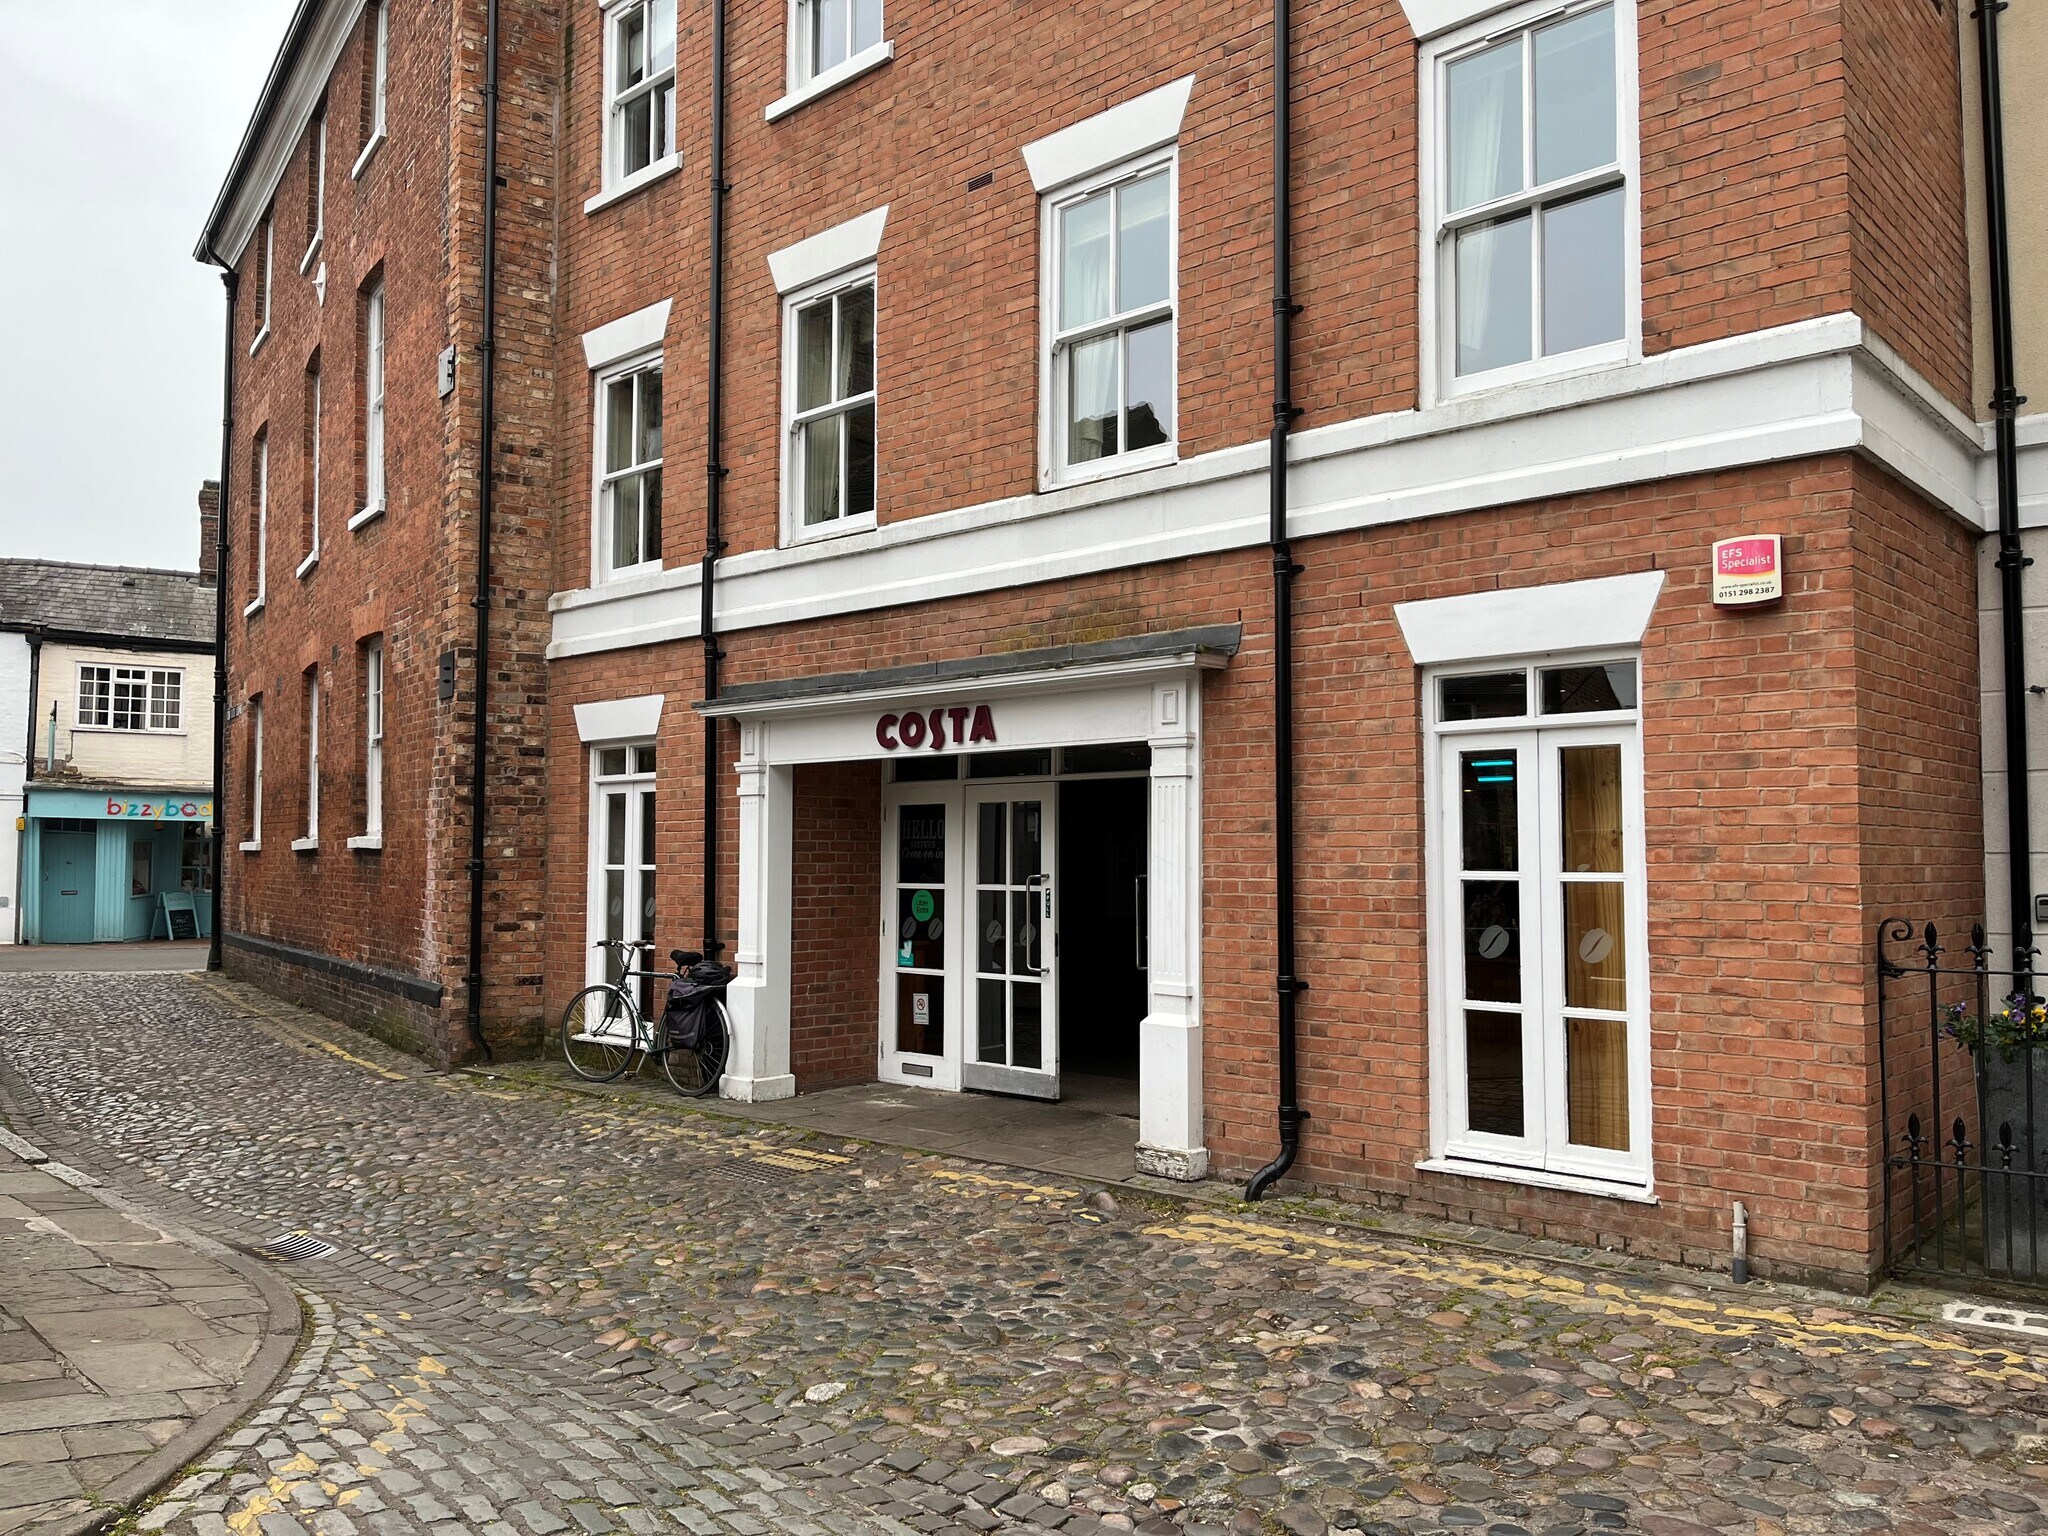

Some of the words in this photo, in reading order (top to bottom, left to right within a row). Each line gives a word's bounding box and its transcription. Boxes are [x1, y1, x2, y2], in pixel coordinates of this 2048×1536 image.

[1721, 548, 1742, 558] EFS
[1722, 555, 1771, 570] Specialist
[1719, 590, 1737, 598] 0151
[1738, 588, 1753, 596] 298
[1754, 586, 1775, 595] 2387
[876, 705, 996, 750] COSTA
[902, 819, 945, 839] HELLO
[902, 846, 922, 859] Come
[923, 850, 934, 859] on
[935, 847, 944, 859] in
